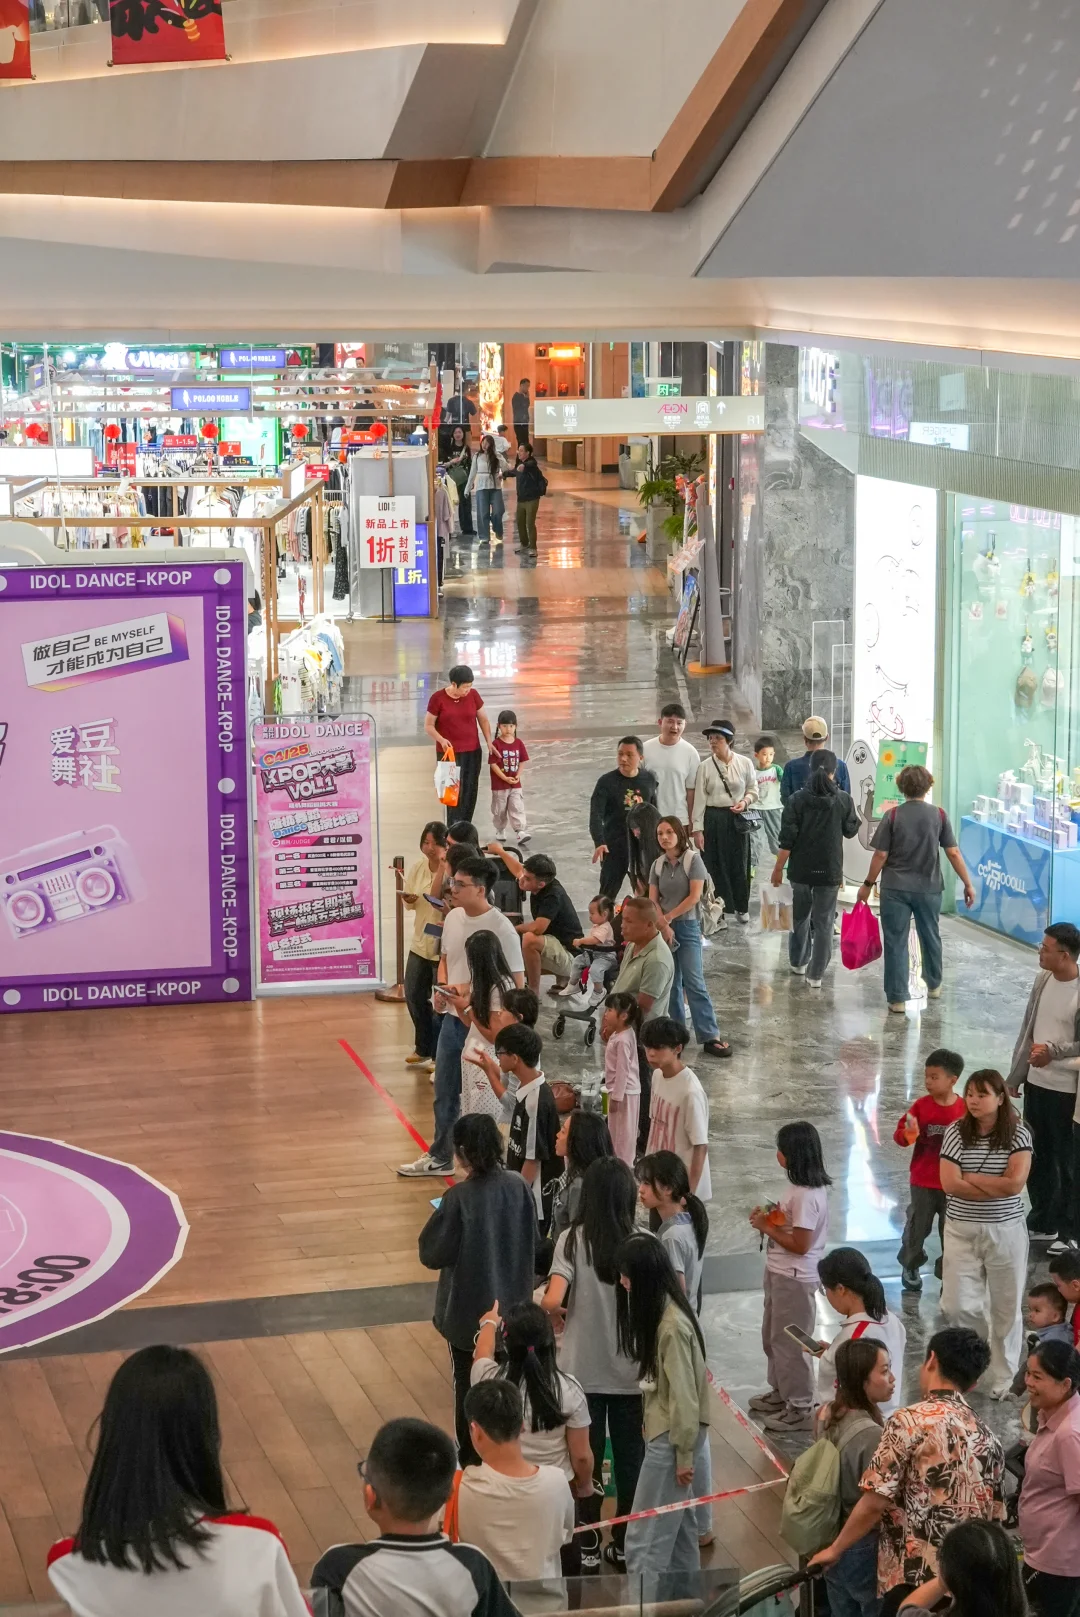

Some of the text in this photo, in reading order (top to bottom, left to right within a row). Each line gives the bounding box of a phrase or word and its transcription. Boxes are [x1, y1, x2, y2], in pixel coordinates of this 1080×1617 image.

[193, 394, 239, 403] POLOO NOBLE
[378, 503, 390, 512] LIDI
[365, 519, 410, 529] 新品上市
[366, 536, 409, 563] 1折 封顶
[30, 571, 192, 589] IDOL DANCE-KPOP
[215, 605, 231, 642] IDOL
[33, 625, 156, 662] 做自己 BE MYSELF
[46, 636, 164, 676] 才能成为自己
[50, 718, 120, 756] 爱豆
[275, 723, 363, 739] IDOL DANCE
[263, 744, 309, 766] 04/25
[51, 755, 121, 792] 舞社
[220, 813, 235, 850] IDOL
[270, 892, 352, 919] 现场报名即送
[43, 981, 202, 1002] IDOL DANCE-KPOP
